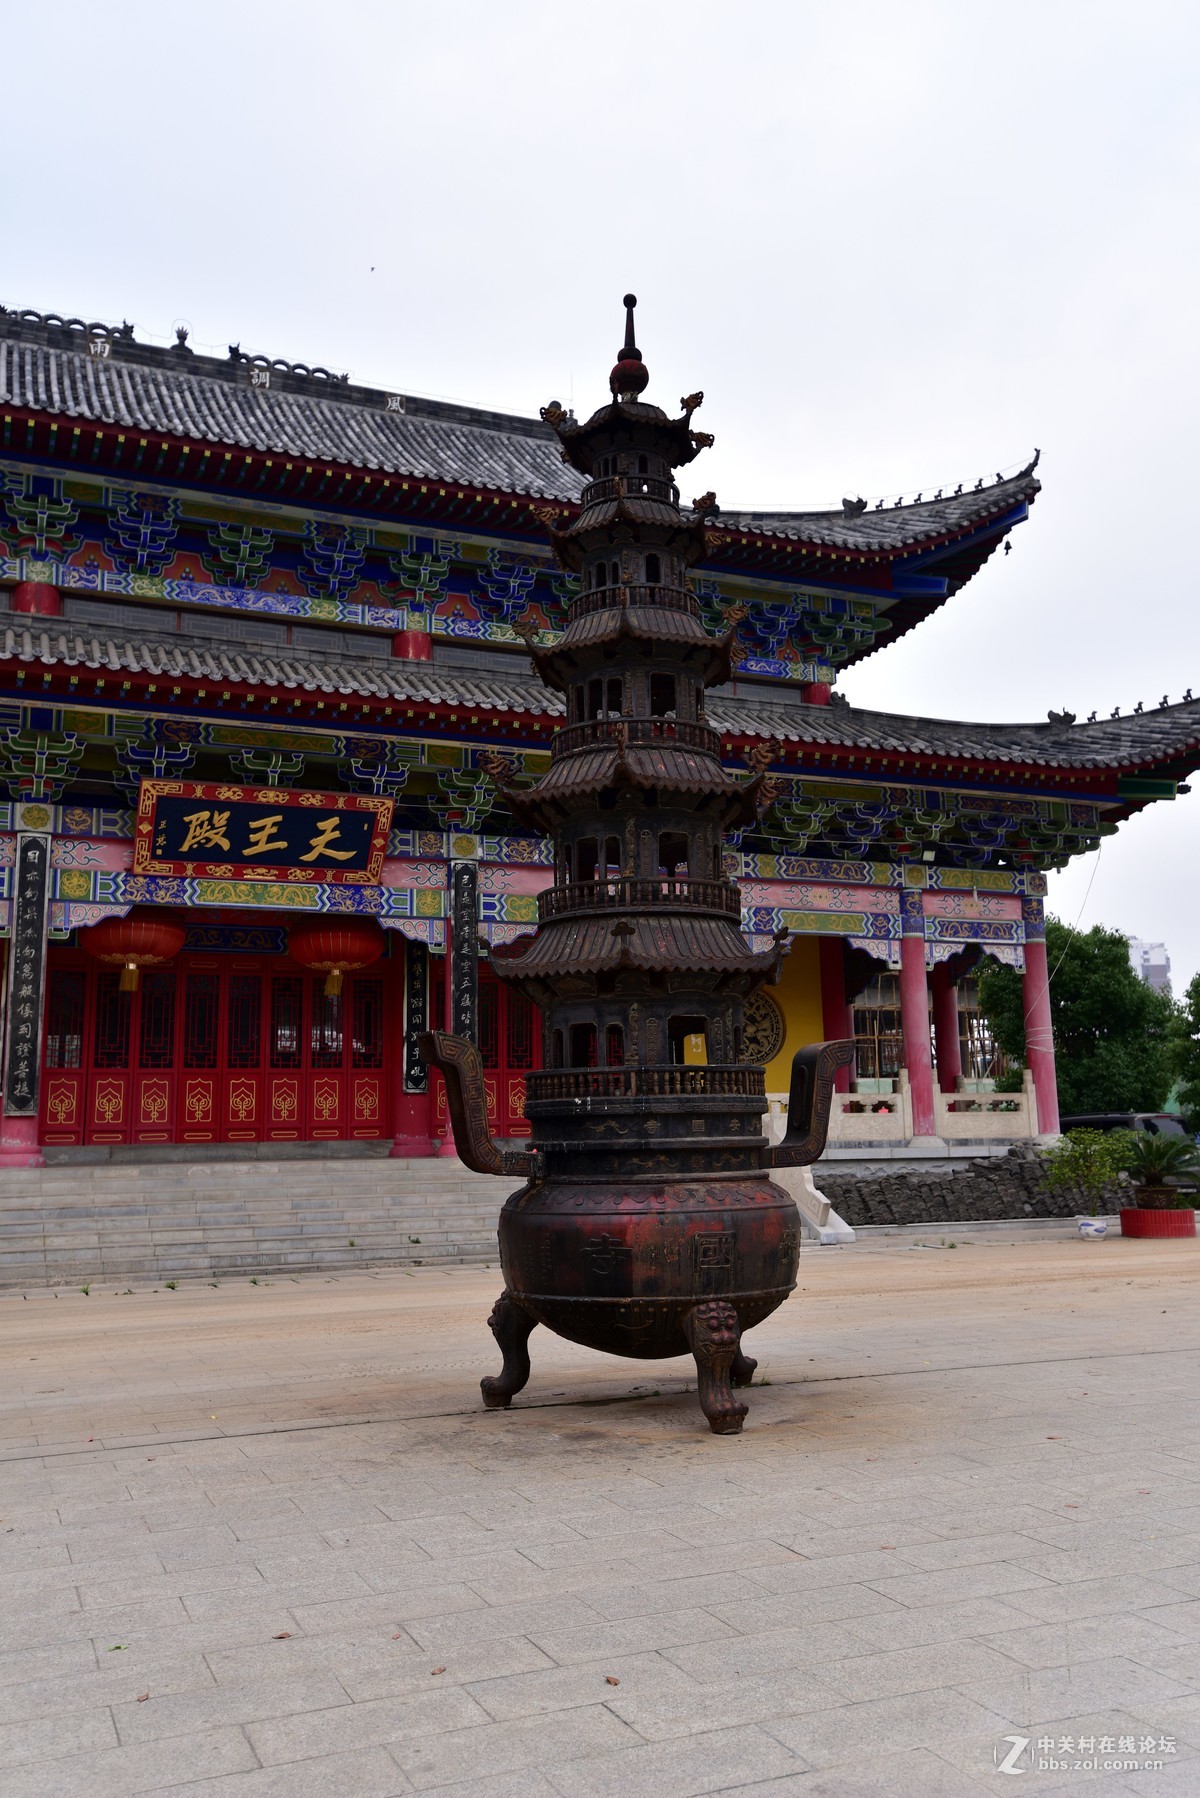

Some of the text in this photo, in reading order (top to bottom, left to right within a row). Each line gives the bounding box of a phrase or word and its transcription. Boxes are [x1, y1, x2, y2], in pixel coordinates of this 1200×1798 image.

[90, 338, 110, 358] 雨
[251, 369, 270, 389] 調
[387, 397, 405, 414] 風
[178, 810, 358, 862] 天王殿
